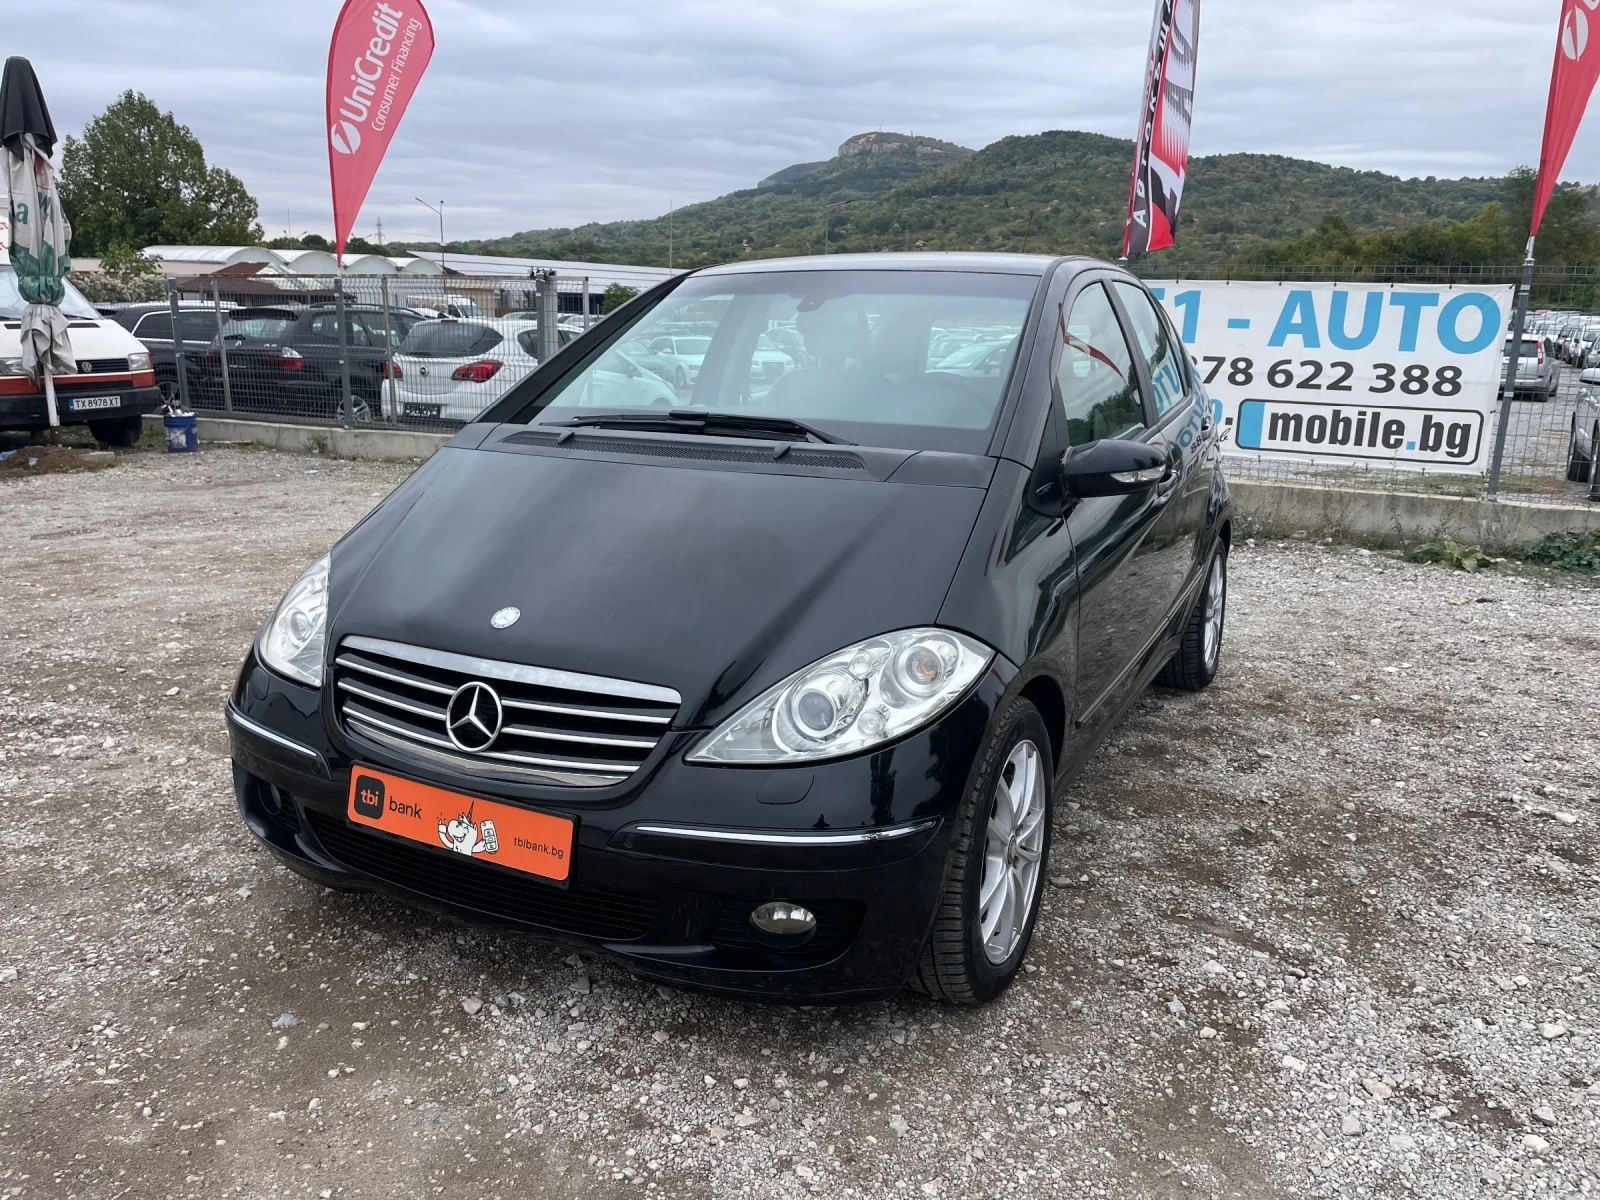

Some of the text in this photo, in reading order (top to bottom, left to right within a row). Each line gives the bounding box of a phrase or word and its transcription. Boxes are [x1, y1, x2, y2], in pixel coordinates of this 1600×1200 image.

[339, 2, 403, 122] UniCredit
[371, 18, 423, 131] Consumer Financing
[1267, 289, 1502, 355] AUTO
[1190, 355, 1254, 386] 78
[1266, 359, 1354, 392] 622
[1368, 363, 1463, 397] 388
[75, 397, 119, 408] TX 8978 XT
[1268, 409, 1472, 458] mobile.bg
[360, 788, 422, 819] tbi bank
[513, 836, 564, 860] tbibank.bg
